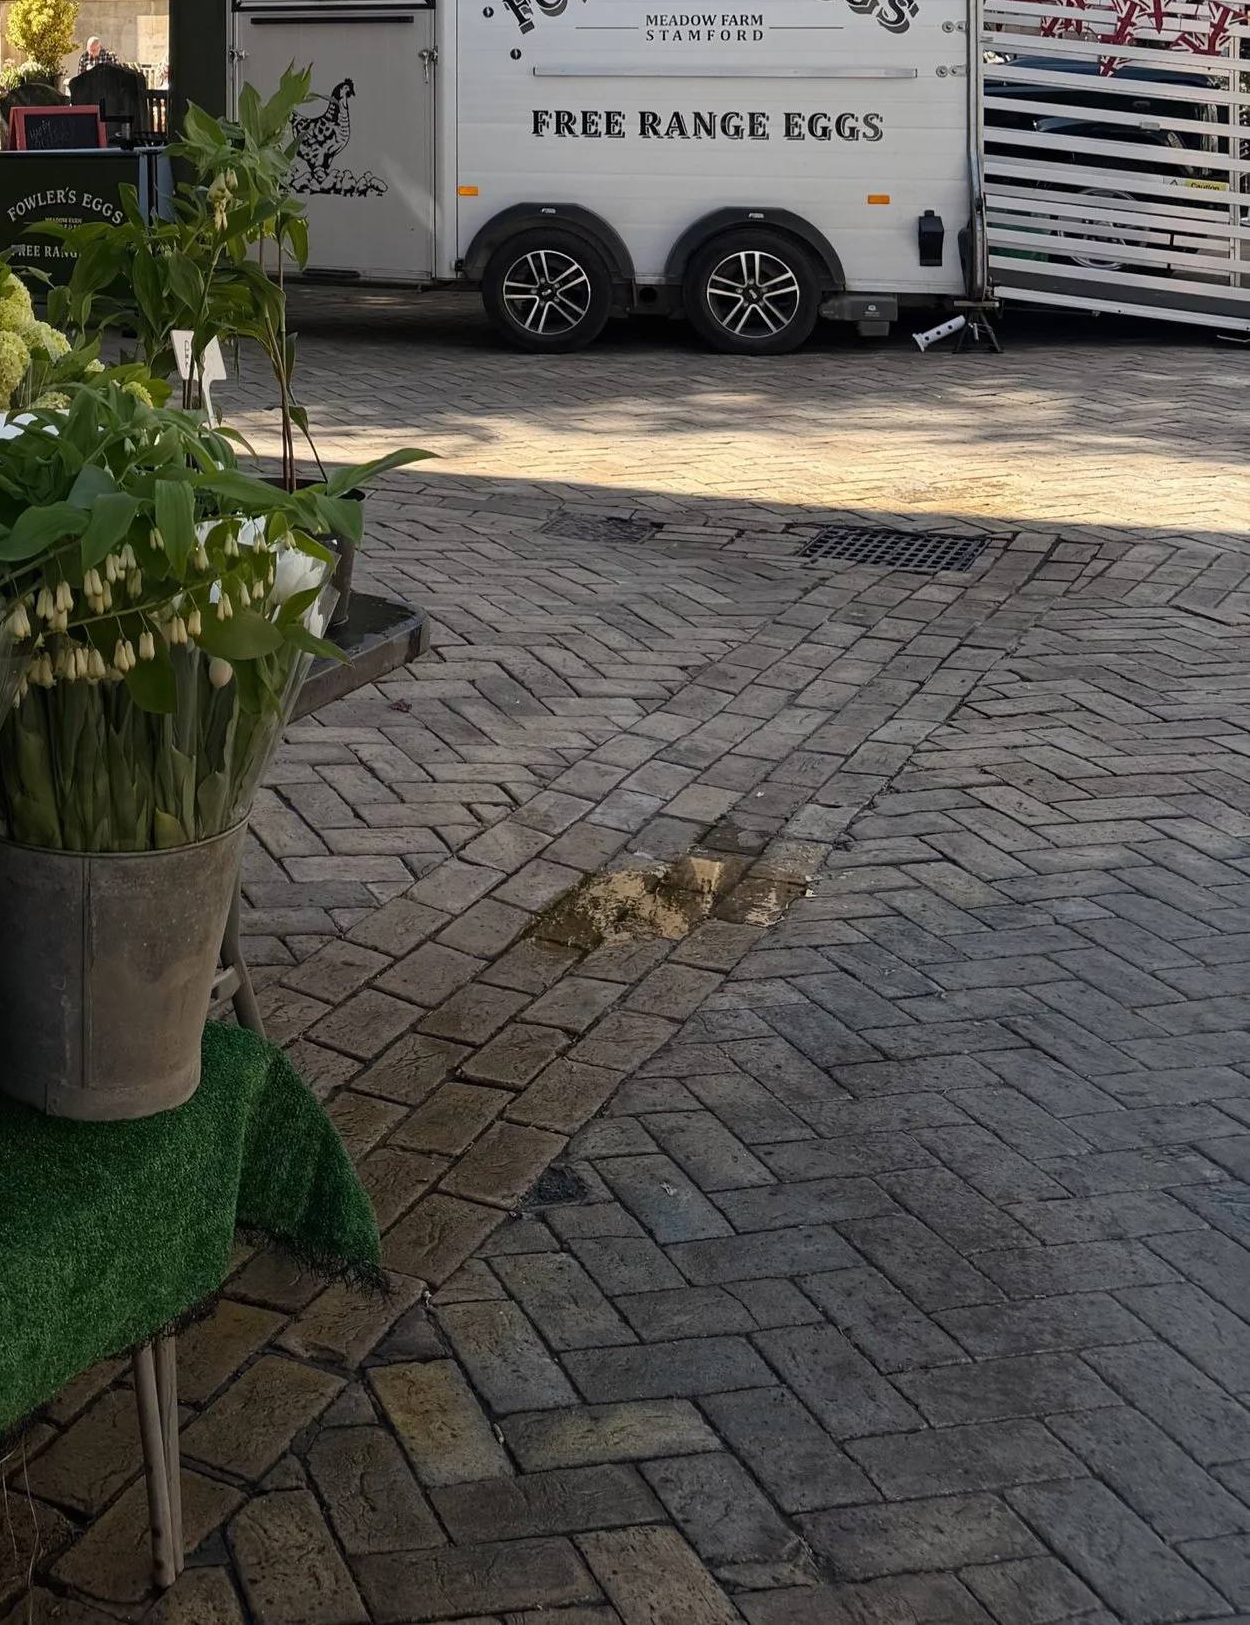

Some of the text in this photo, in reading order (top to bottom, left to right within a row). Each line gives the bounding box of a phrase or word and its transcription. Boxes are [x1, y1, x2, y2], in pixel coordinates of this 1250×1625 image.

[645, 14, 763, 27] MEADOW FARM
[645, 29, 763, 42] STAMFORD
[530, 109, 885, 142] FREE RANGE EGGS
[6, 186, 124, 225] FOWLER'S EGGS
